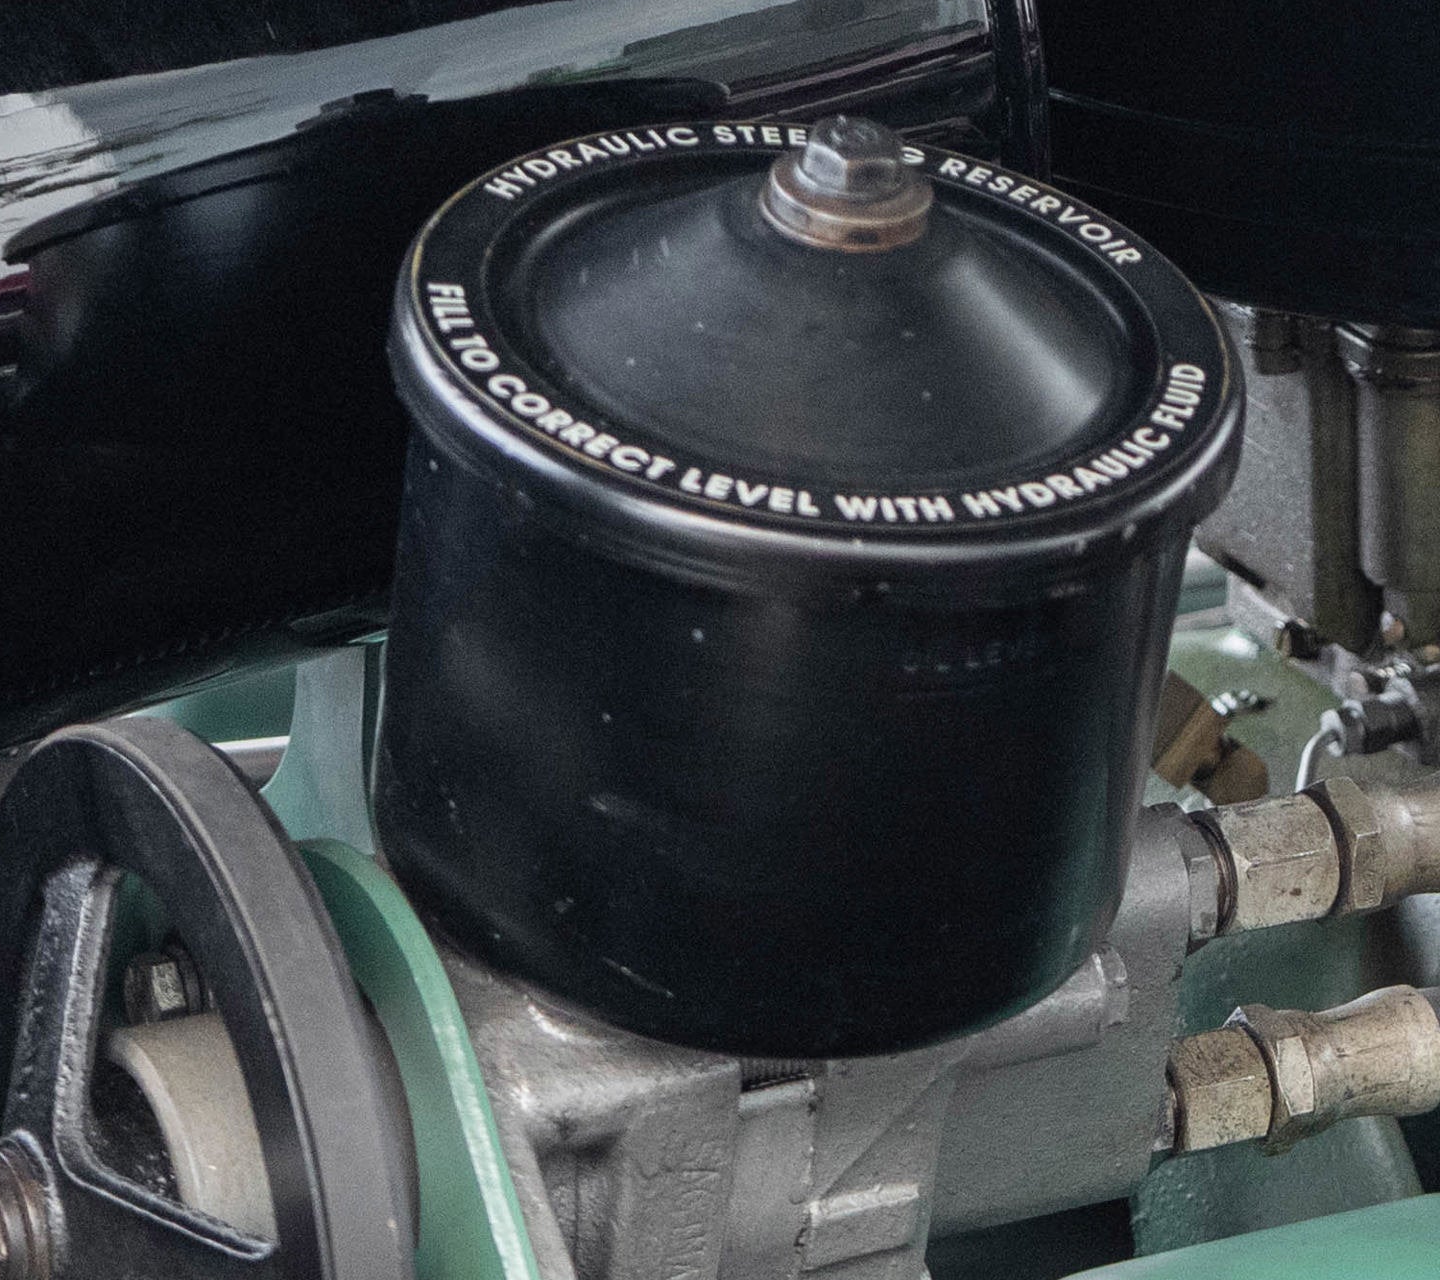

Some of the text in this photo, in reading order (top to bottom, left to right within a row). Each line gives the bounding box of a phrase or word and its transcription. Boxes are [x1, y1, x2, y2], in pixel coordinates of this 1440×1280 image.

[483, 124, 1143, 265] HYDRAULIC STEEG RESERVOIR
[427, 282, 1207, 523] FILL TO CORRECT LEVEL WITH HYDRAULIC FLUID
